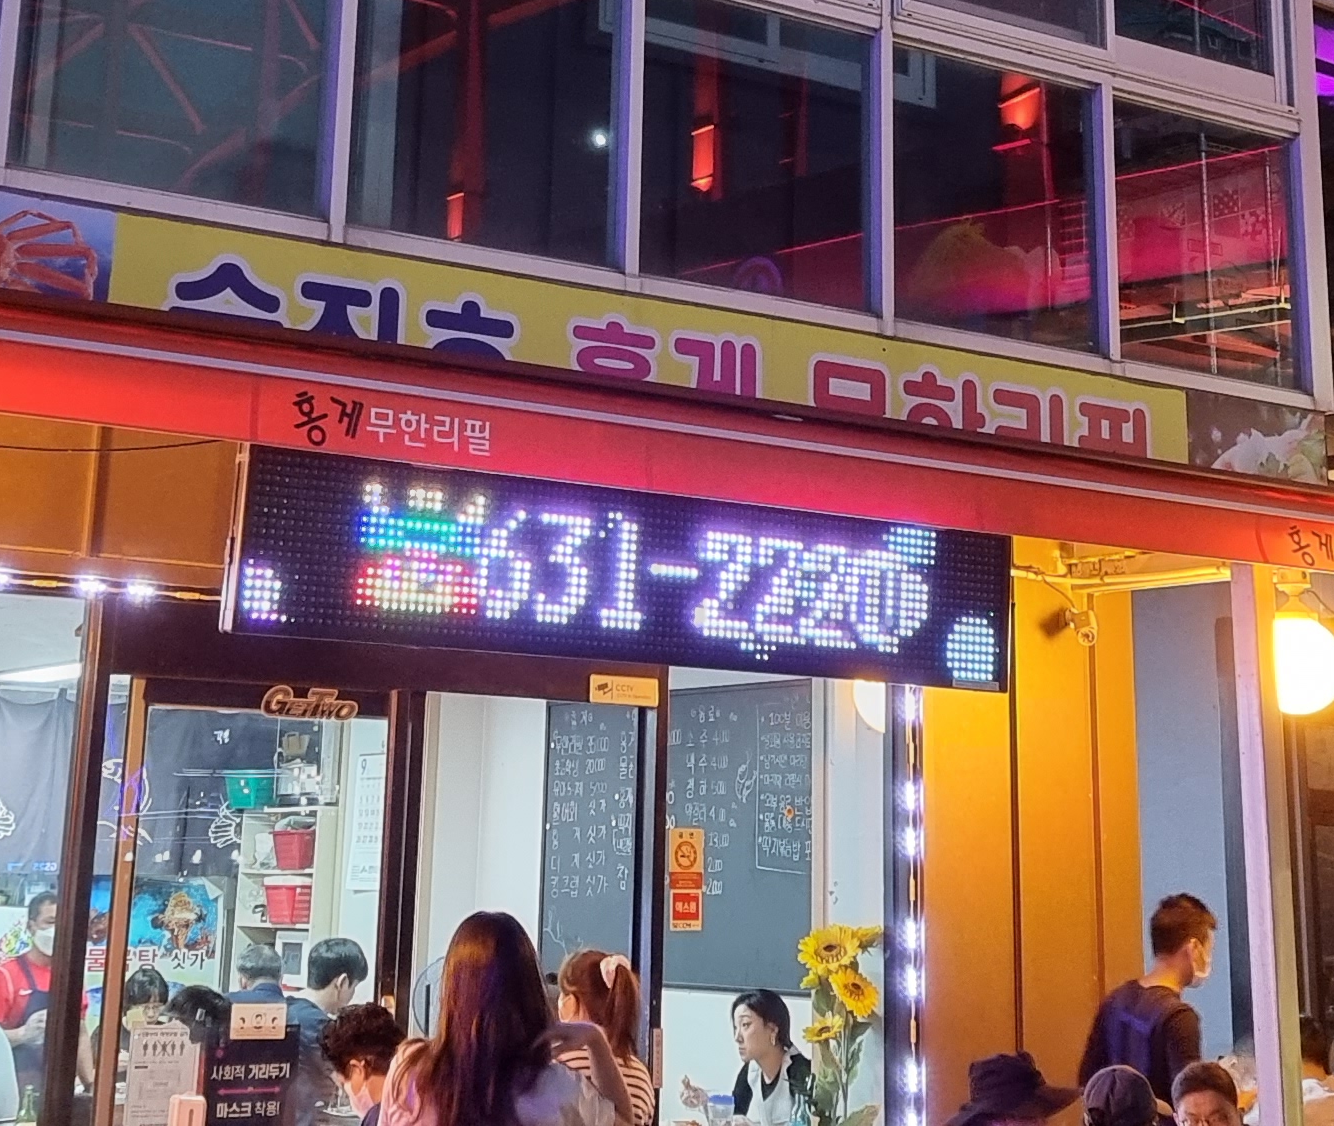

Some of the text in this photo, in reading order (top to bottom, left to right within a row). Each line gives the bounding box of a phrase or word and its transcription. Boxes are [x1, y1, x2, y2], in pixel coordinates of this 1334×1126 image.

[292, 391, 492, 457] 홍게 무한리필
[1288, 525, 1334, 567] 홍게
[170, 951, 206, 970] 싯가
[210, 1063, 291, 1081] 사회적 거리두기
[216, 1101, 280, 1119] 마스크 착용!
